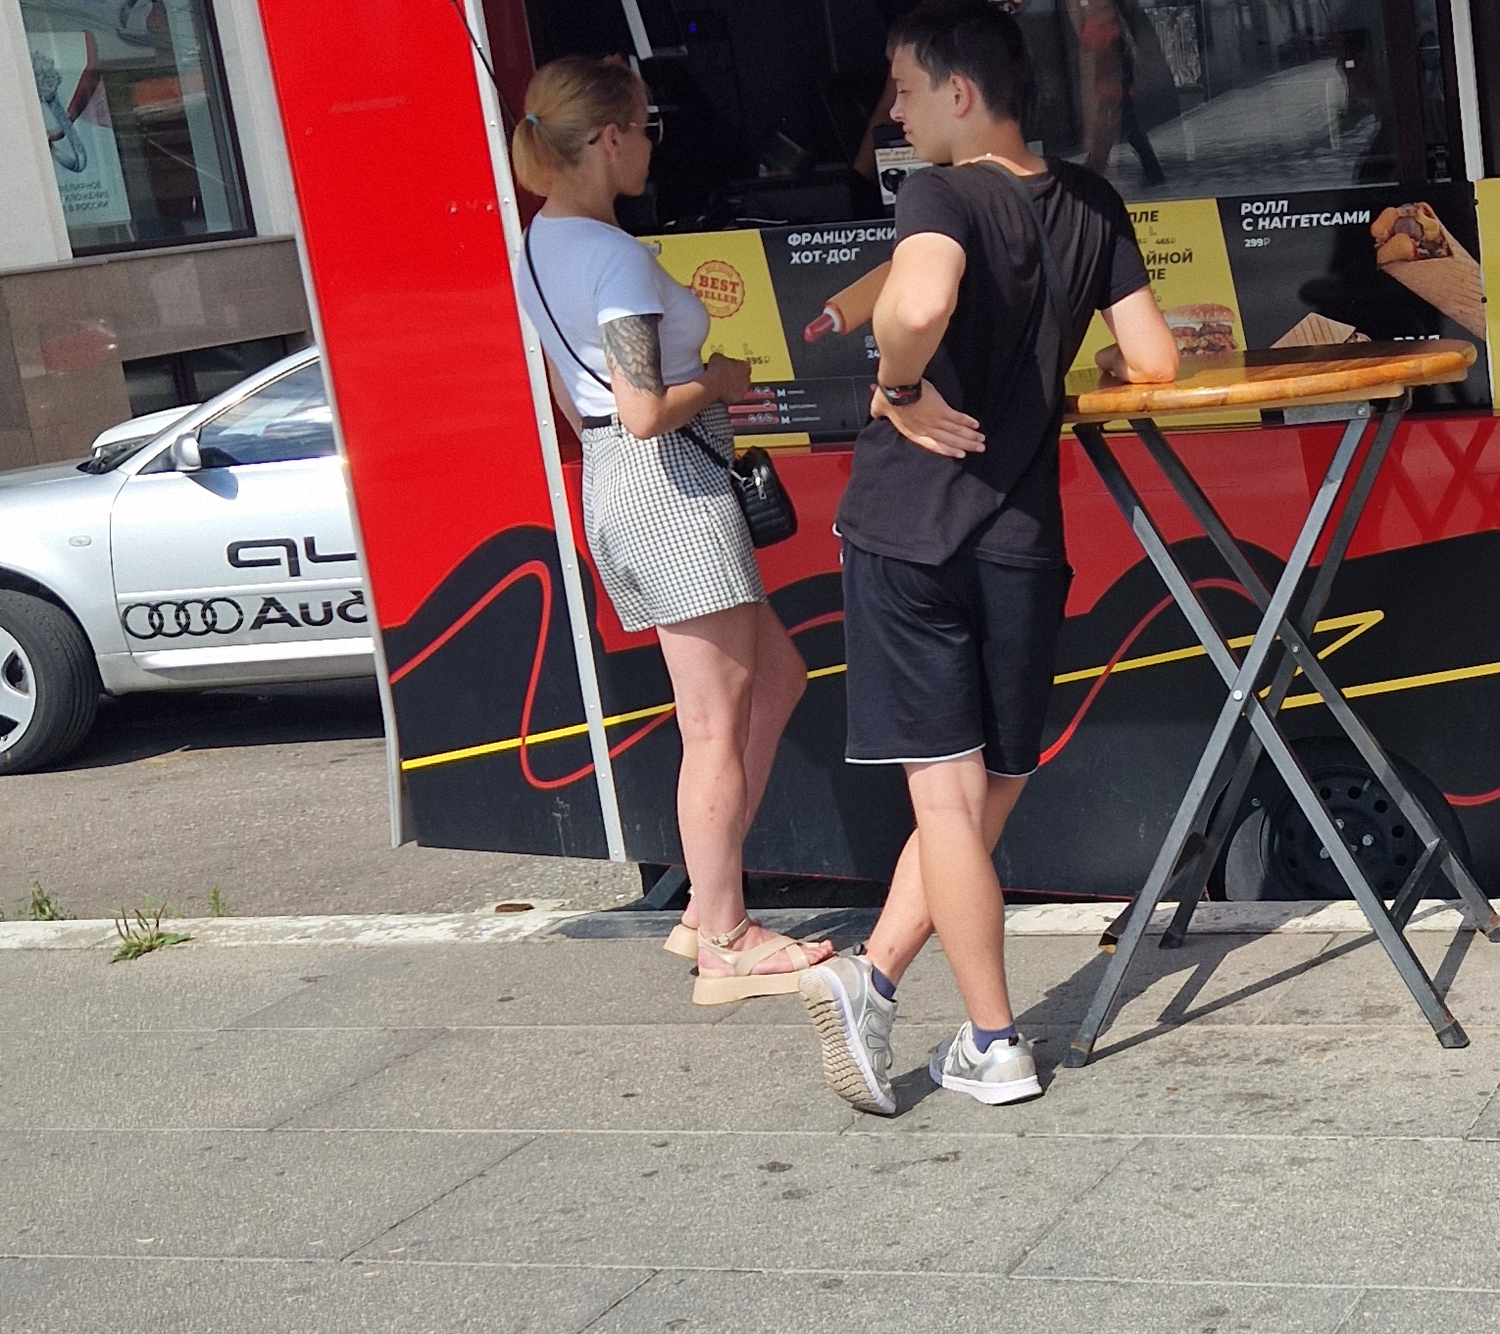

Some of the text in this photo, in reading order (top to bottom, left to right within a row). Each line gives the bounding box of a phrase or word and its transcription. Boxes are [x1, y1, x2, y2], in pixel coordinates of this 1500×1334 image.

[1240, 200, 1289, 216] РОЛЛ
[1242, 210, 1370, 231] С НАГГЕТСАМИ
[787, 227, 897, 246] ФРАНЦУЗСКИ
[790, 247, 860, 264] ХОТ-ДОГ
[1146, 248, 1193, 265] ЙНОЙ
[699, 275, 739, 292] BEST
